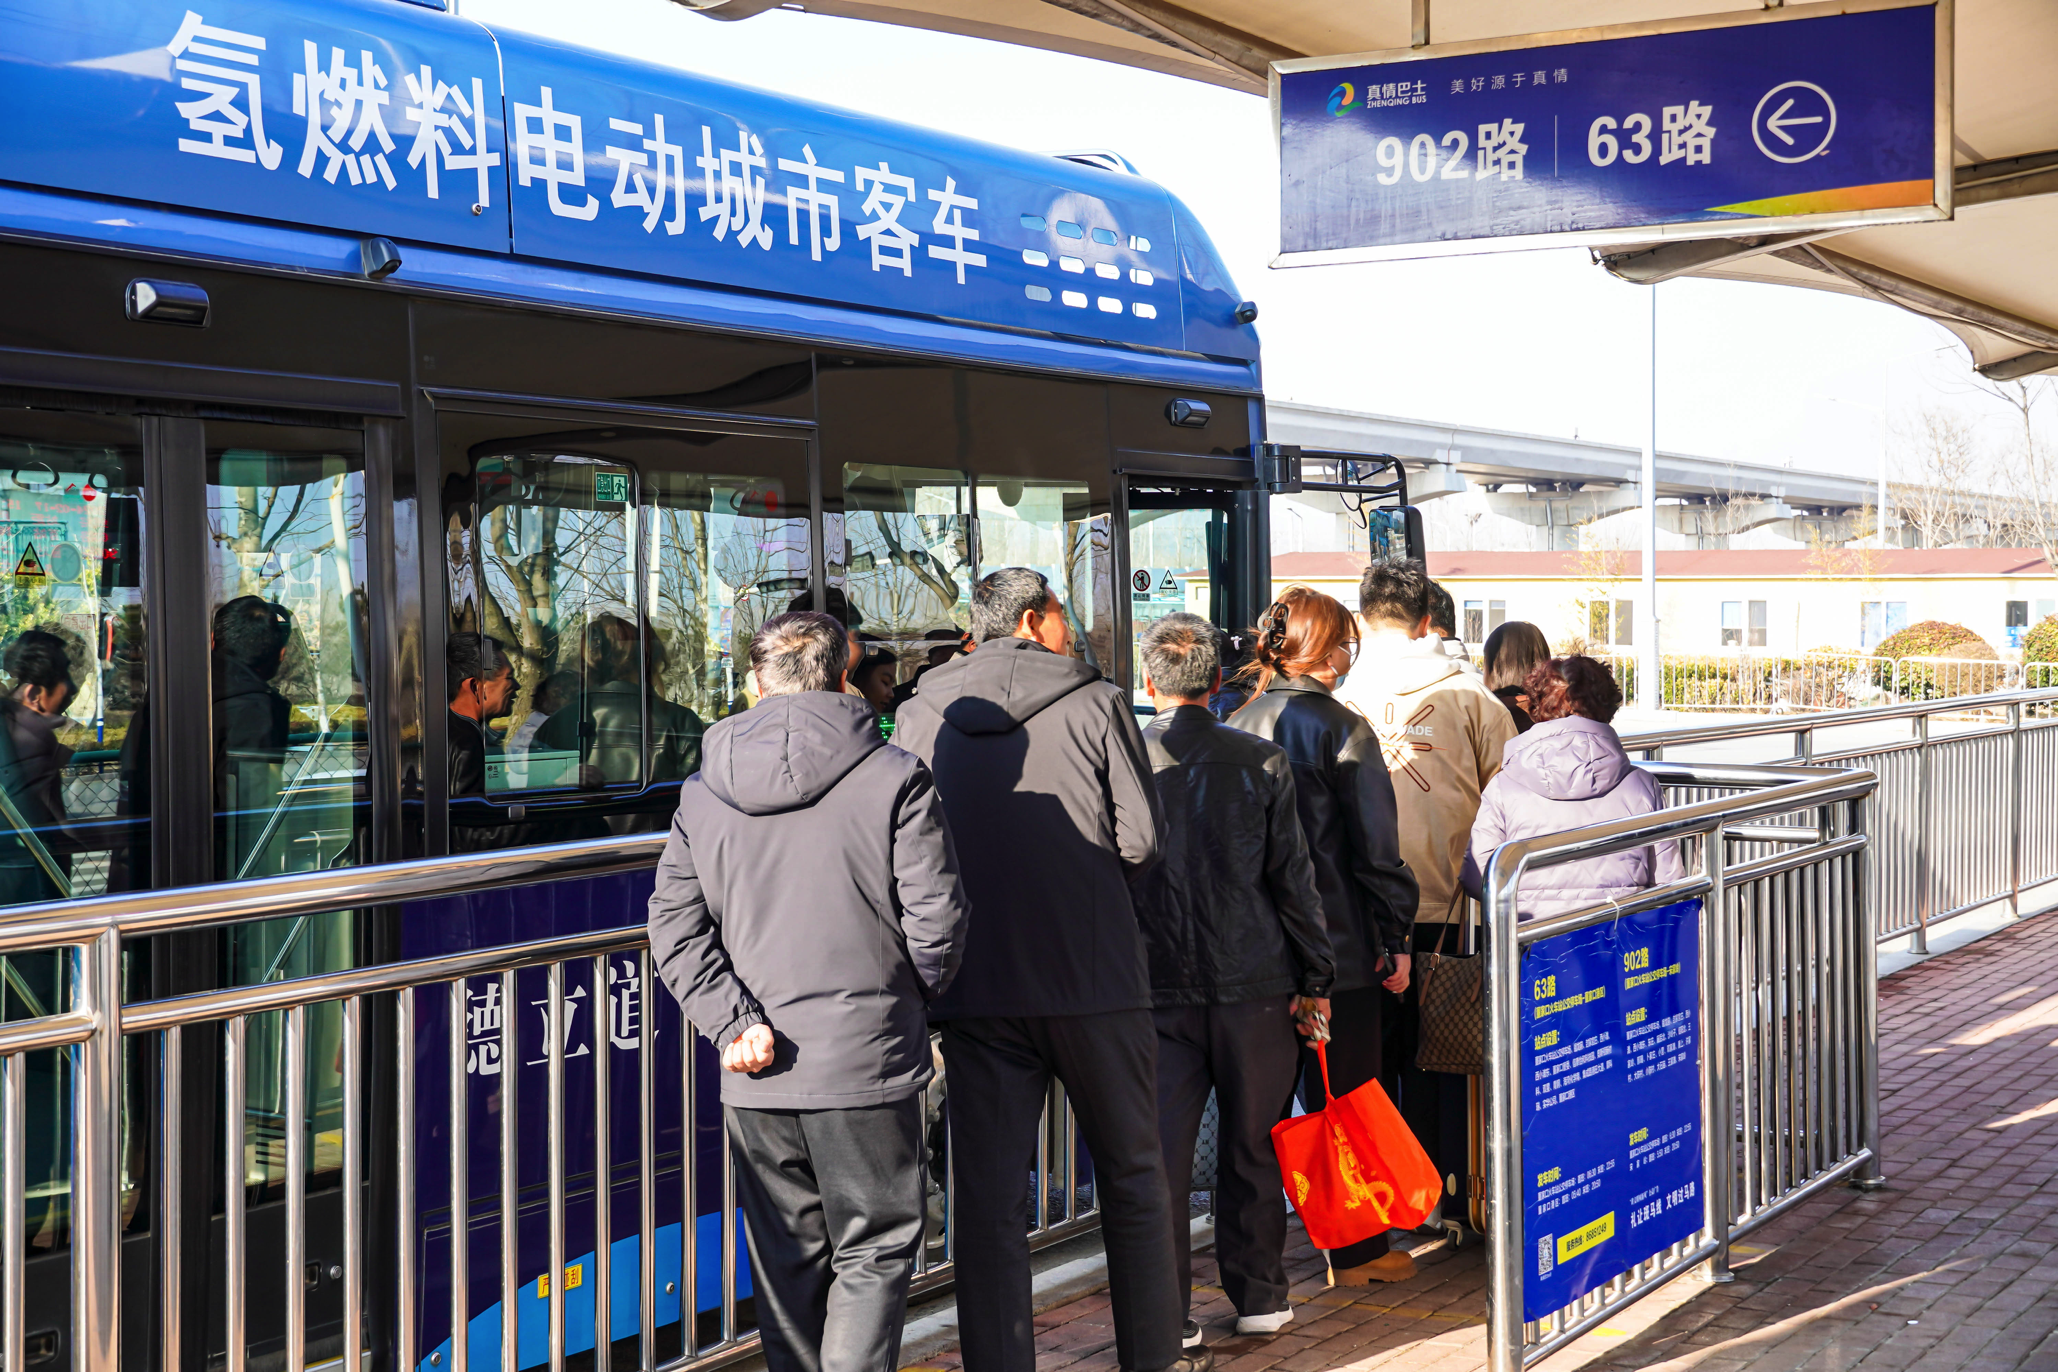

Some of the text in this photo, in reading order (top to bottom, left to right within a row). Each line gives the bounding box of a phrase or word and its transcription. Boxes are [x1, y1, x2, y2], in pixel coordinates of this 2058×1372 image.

[1366, 80, 1427, 101] 真情巴士
[1450, 68, 1569, 94] 美好源于真情
[1366, 95, 1427, 108] ZHENQING BUS
[167, 10, 988, 285] 氢燃料电动城市客车
[1586, 100, 1717, 169] 63路
[1374, 117, 1530, 187] 902路
[1403, 725, 1432, 736] ADE
[1623, 946, 1649, 973] 902路
[1534, 974, 1556, 1000] 63路
[1630, 1198, 1663, 1229] 礼让斑马线
[1665, 1181, 1696, 1210] 文明过马路
